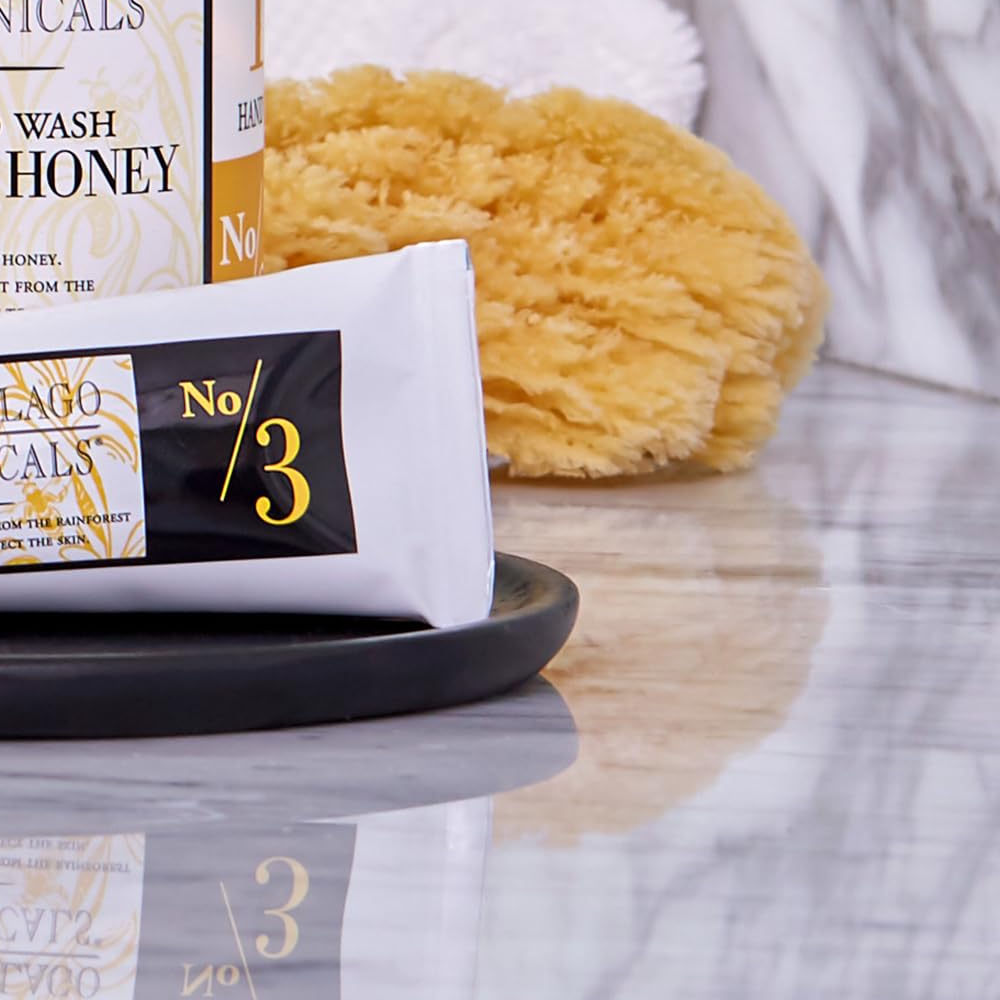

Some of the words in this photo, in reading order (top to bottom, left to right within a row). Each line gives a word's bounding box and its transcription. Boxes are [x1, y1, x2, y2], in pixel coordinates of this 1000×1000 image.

[238, 96, 264, 132] HAN
[14, 109, 116, 140] WASH
[5, 143, 180, 199] HONEY
[2, 253, 62, 266] HONEY.
[15, 281, 59, 293] FROM
[64, 280, 95, 292] THE
[26, 517, 52, 529] THE
[55, 512, 132, 528] RAINFOREST
[27, 536, 53, 548] THE
[57, 533, 90, 546] SKIN.
